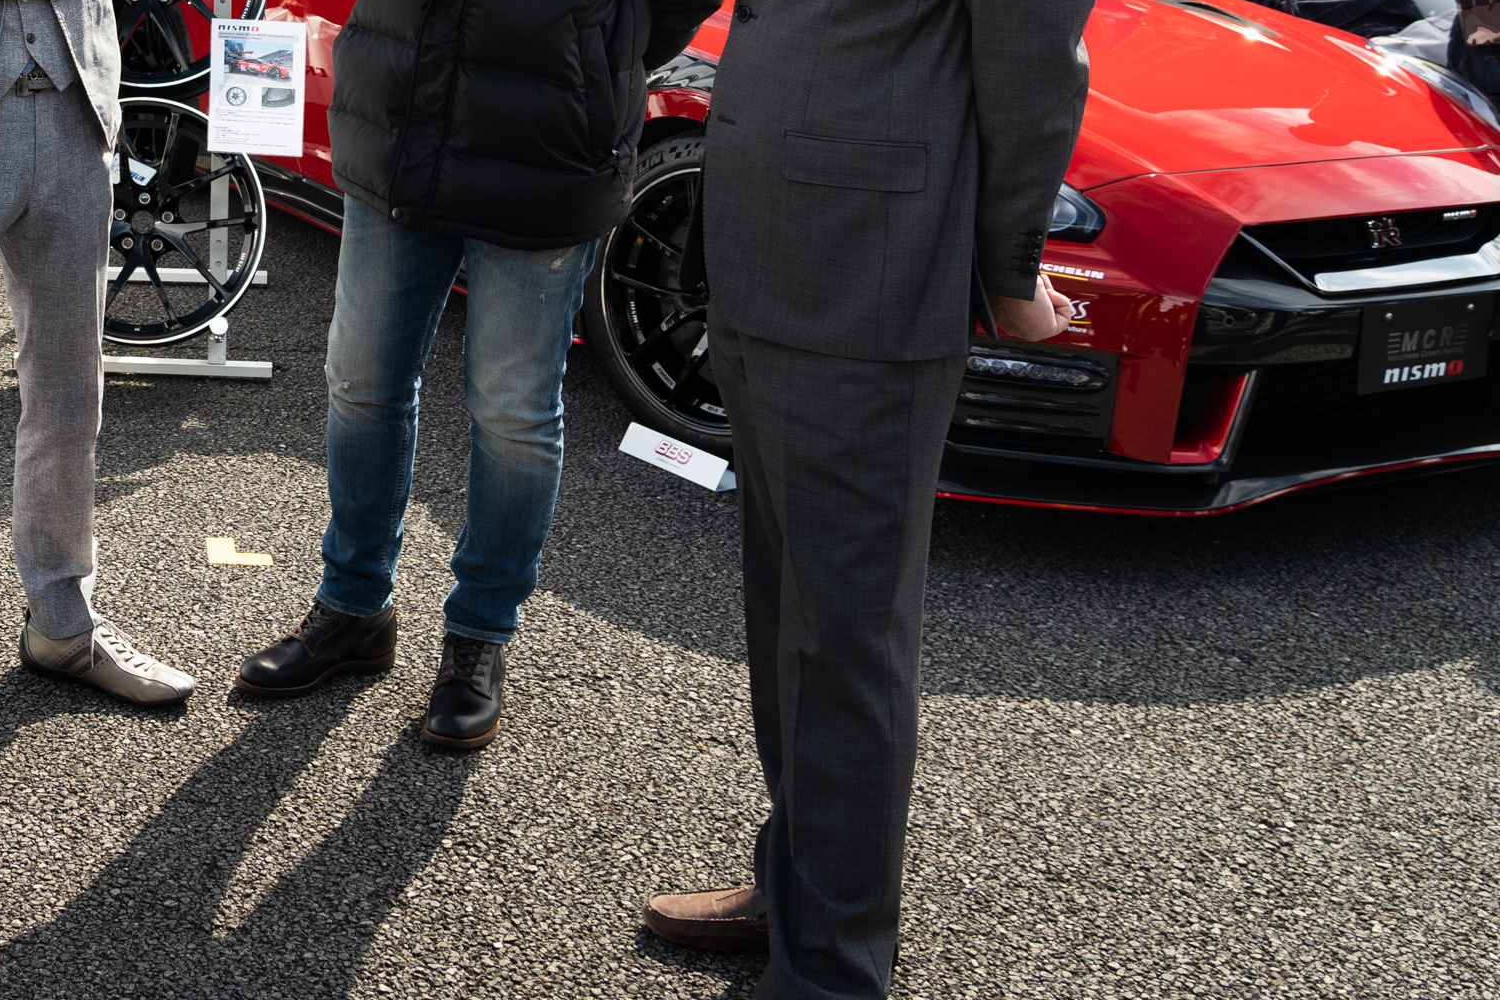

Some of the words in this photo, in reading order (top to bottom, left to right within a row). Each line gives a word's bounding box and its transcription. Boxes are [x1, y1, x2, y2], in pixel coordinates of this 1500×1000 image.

[1039, 263, 1105, 279] ICHELIN
[1401, 327, 1454, 352] MCR
[1383, 360, 1463, 384] nismo
[654, 439, 693, 465] BBS
